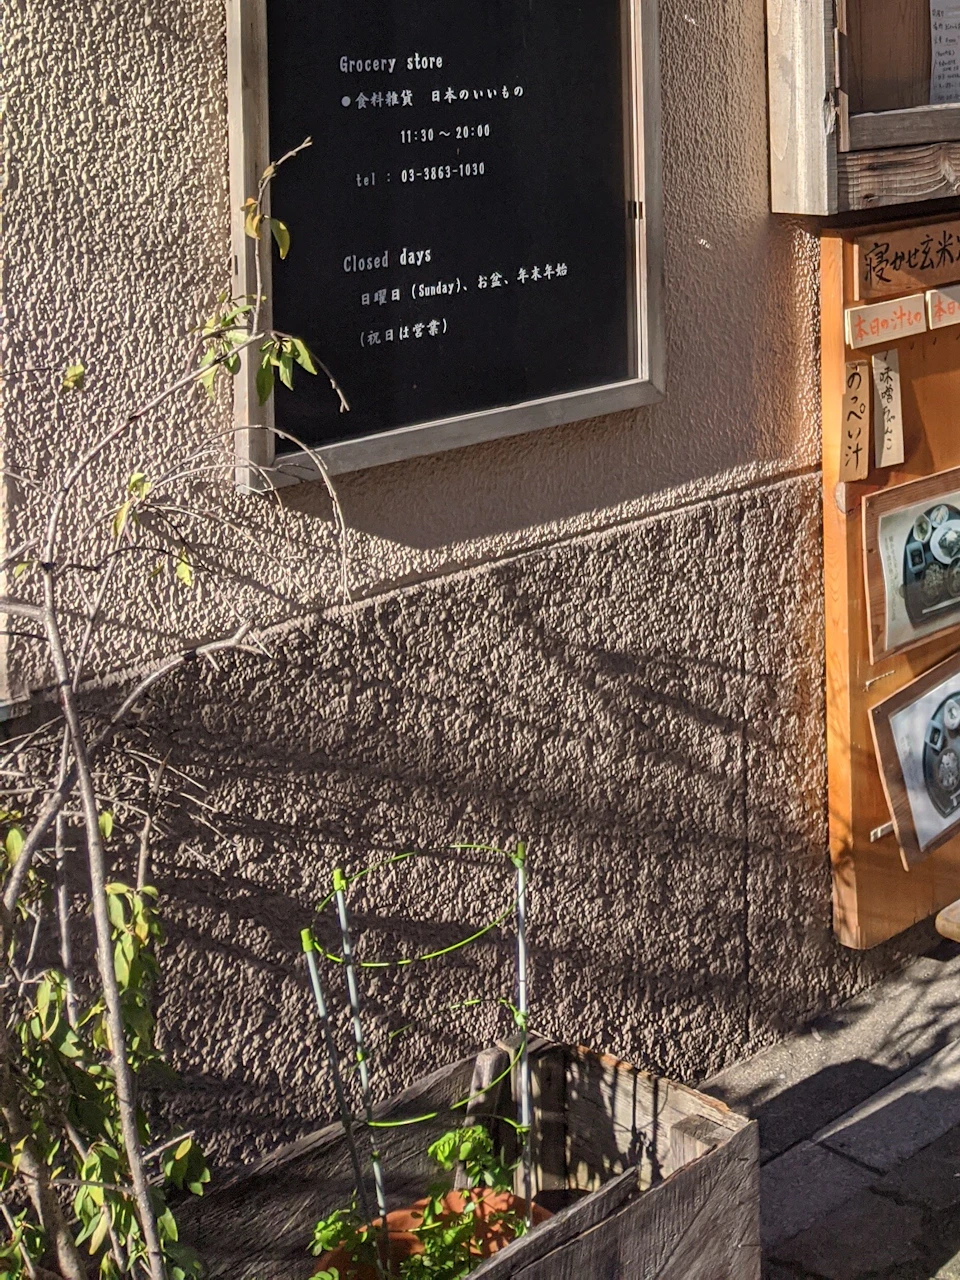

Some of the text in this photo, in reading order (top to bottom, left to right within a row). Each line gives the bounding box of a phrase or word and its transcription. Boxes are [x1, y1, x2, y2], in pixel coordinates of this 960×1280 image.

[339, 52, 443, 74] Grocery store
[355, 85, 524, 110] 食料雑貨 日本のいいもの
[356, 172, 376, 187] tel
[401, 161, 485, 183] 03-3863-1030
[343, 247, 432, 273] Closed days
[360, 317, 447, 347] (祝日は営業)
